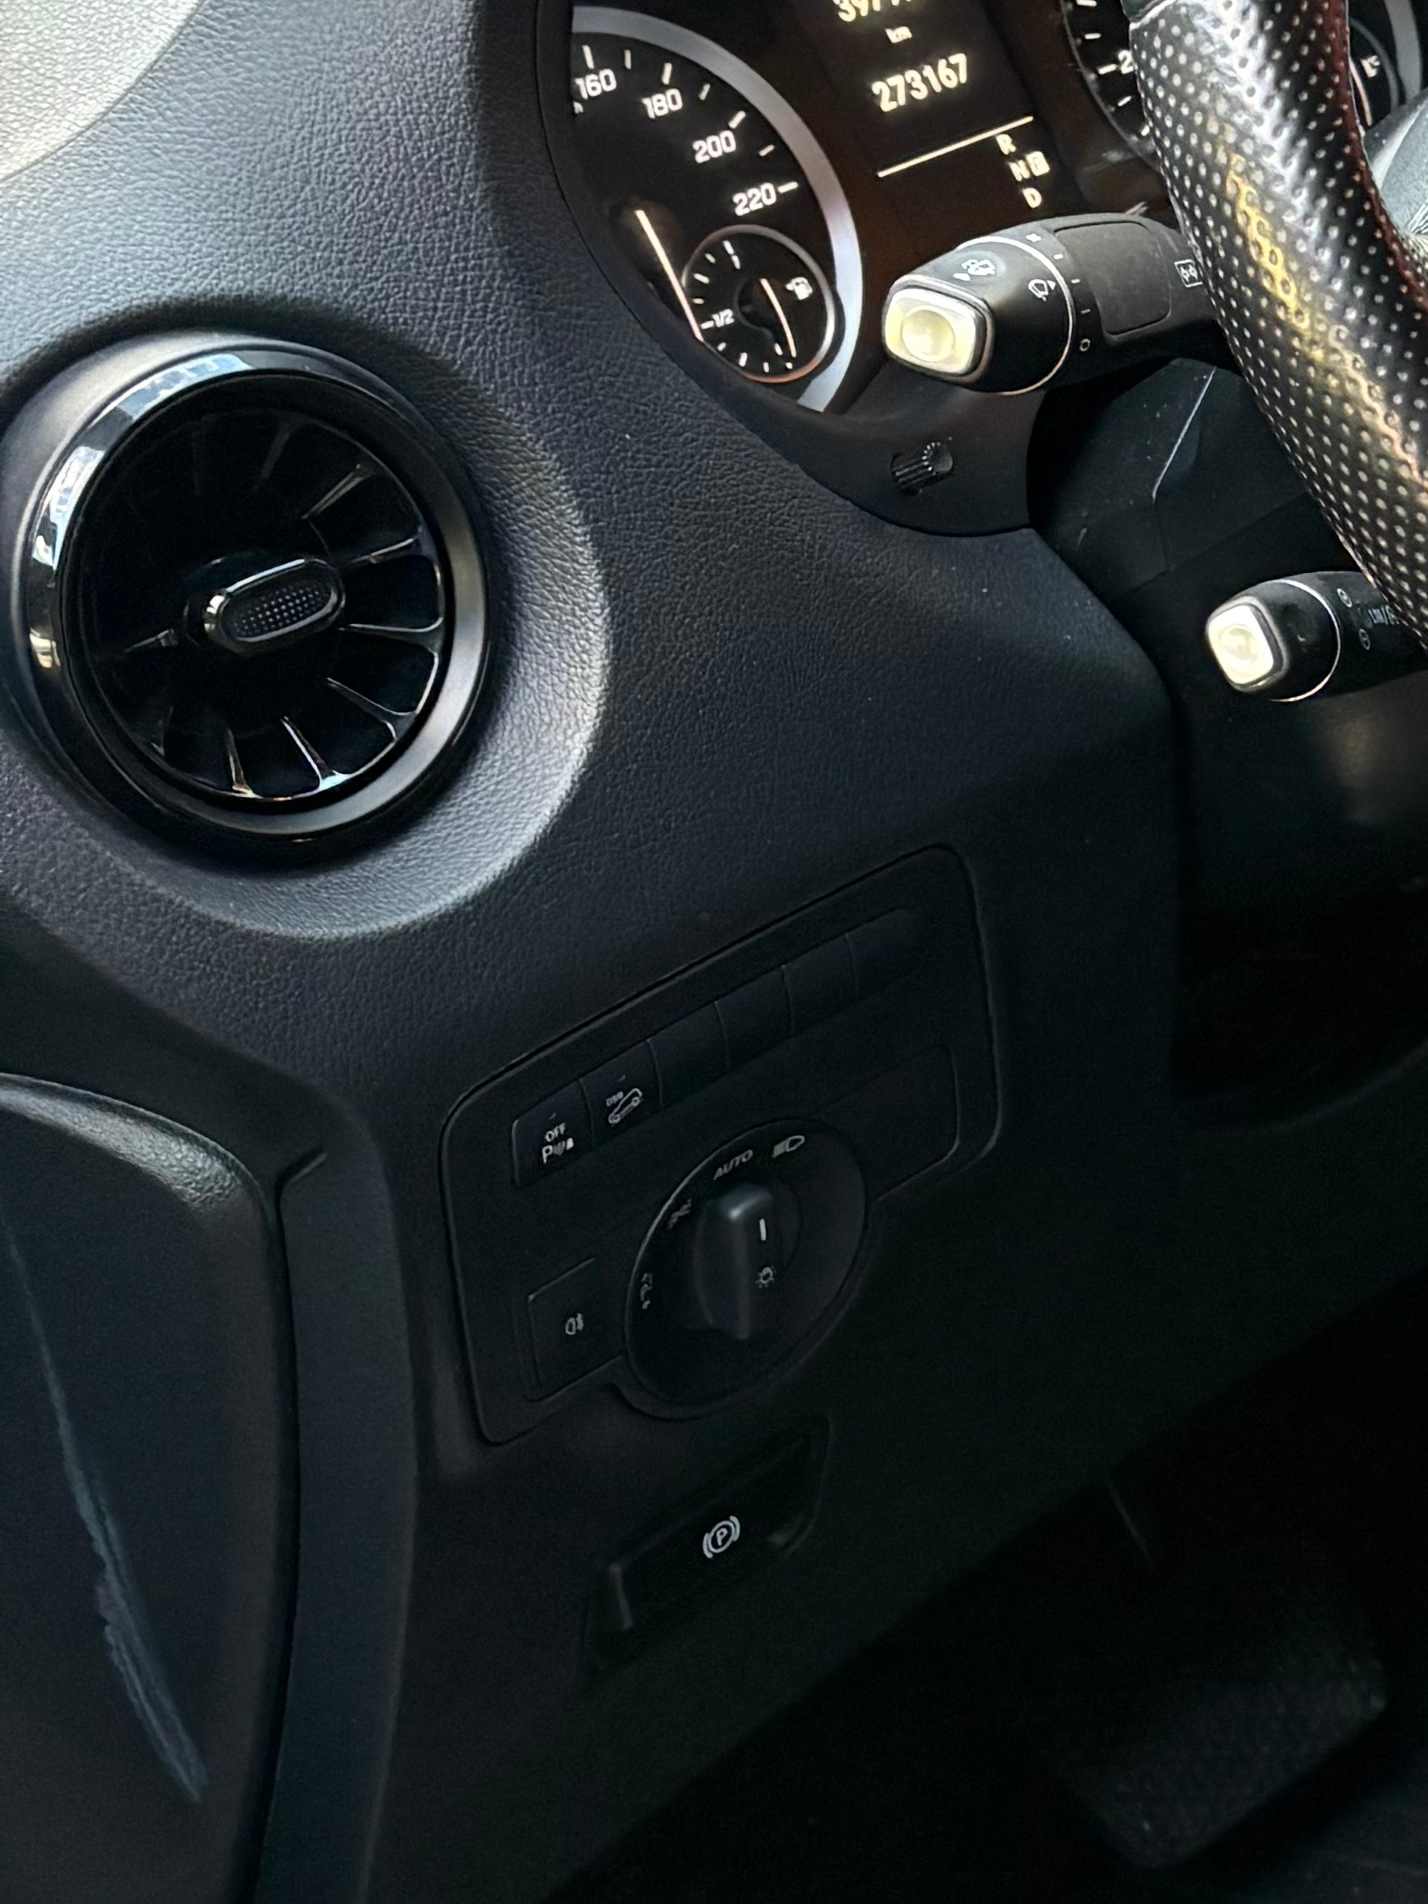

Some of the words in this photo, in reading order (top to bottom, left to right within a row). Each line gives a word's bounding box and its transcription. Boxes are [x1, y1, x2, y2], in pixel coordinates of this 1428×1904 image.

[1118, 49, 1134, 75] 2
[575, 68, 617, 100] 160
[871, 53, 968, 112] 273167
[641, 88, 684, 119] 180
[692, 130, 737, 164] 200
[996, 133, 1017, 156] R
[731, 182, 778, 217] 220
[1021, 187, 1043, 209] D
[713, 1148, 754, 1181] AUTO
